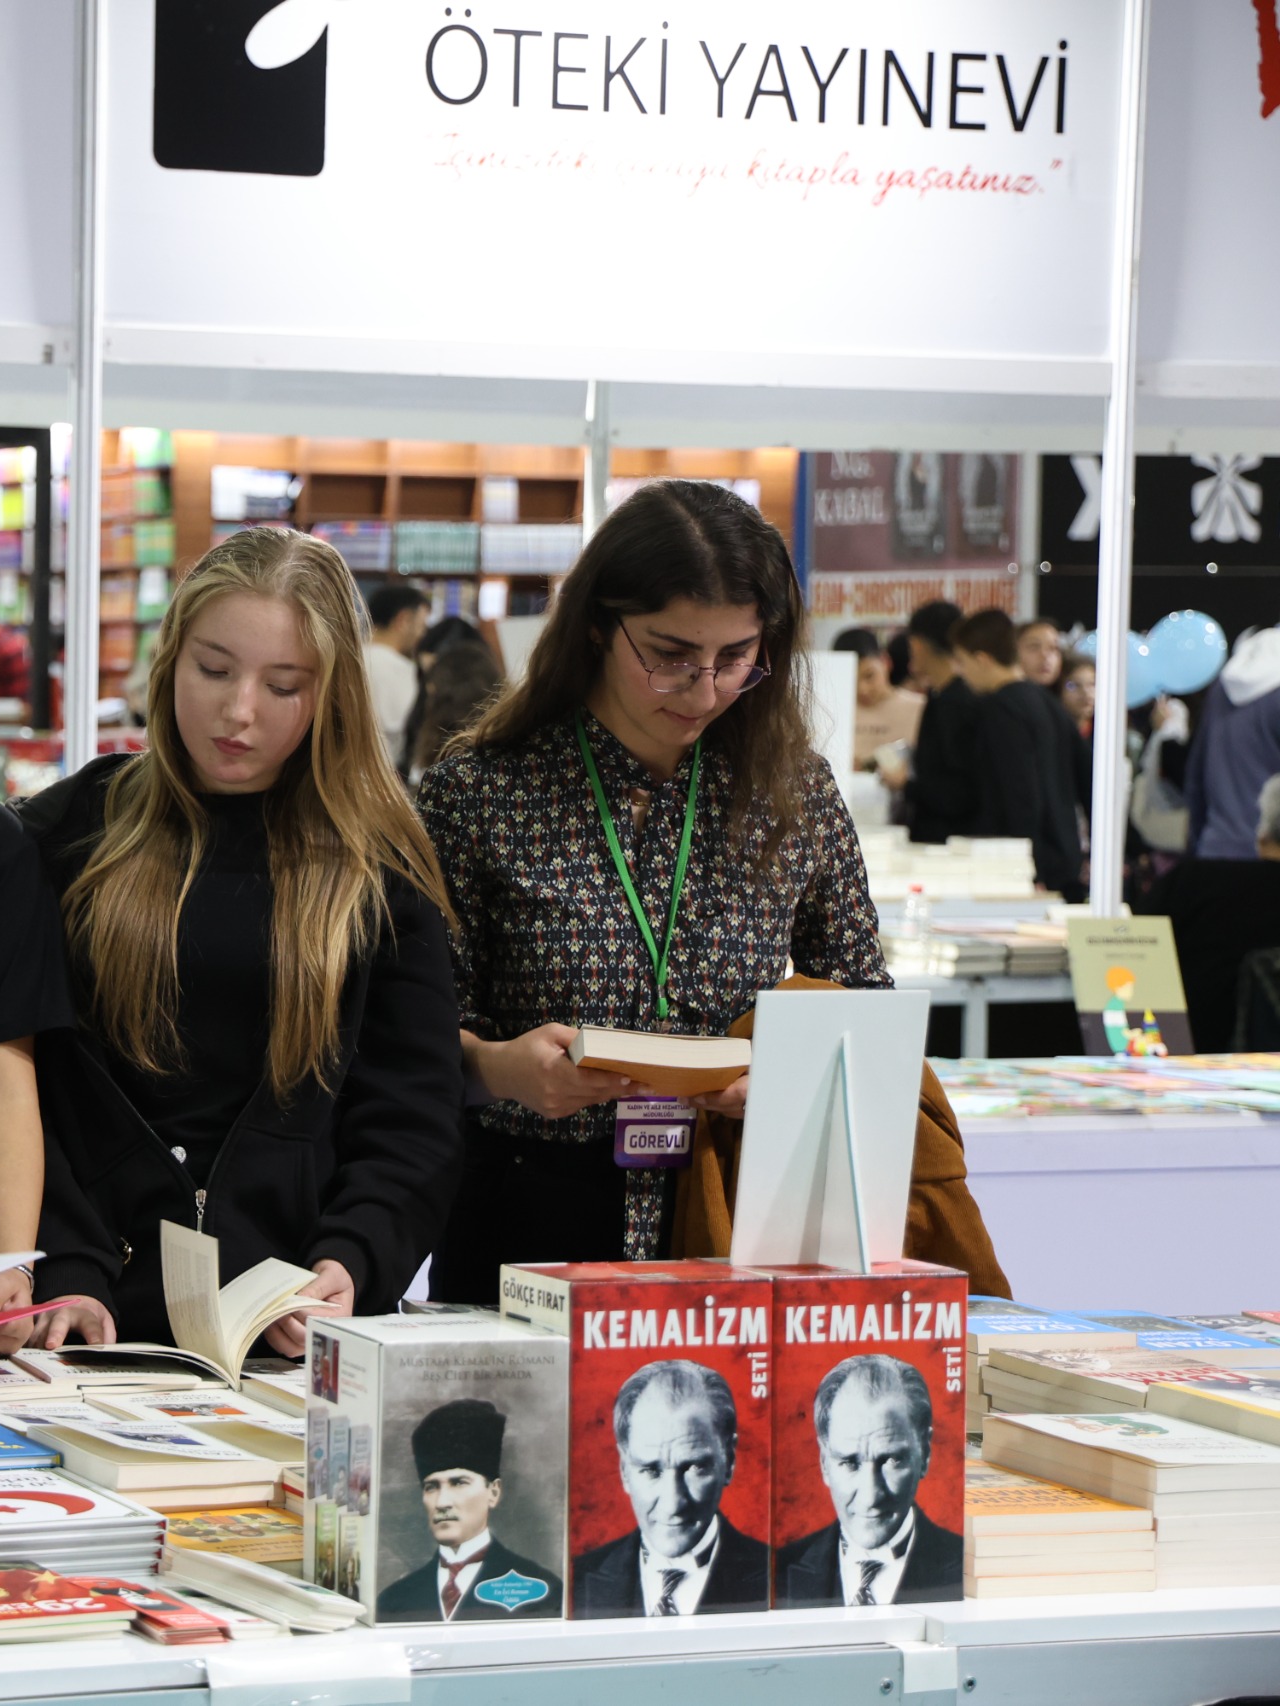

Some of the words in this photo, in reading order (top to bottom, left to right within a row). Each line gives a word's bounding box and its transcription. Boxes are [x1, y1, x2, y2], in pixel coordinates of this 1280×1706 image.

[425, 6, 669, 116] ÖTEKİ
[698, 39, 1068, 135] YAYINEVİ
[629, 1130, 686, 1149] GÖREVLİ
[503, 1277, 535, 1308] GÖKÇE
[537, 1288, 566, 1313] FIRAT
[784, 1290, 962, 1343] KEMALİZM
[583, 1294, 769, 1350] KEMALİZM
[400, 1355, 450, 1367] MUSTAFA
[509, 1354, 556, 1366] ROMANI
[750, 1350, 768, 1399] SETİ
[945, 1346, 962, 1393] SETİ
[32, 1597, 107, 1613] 29
